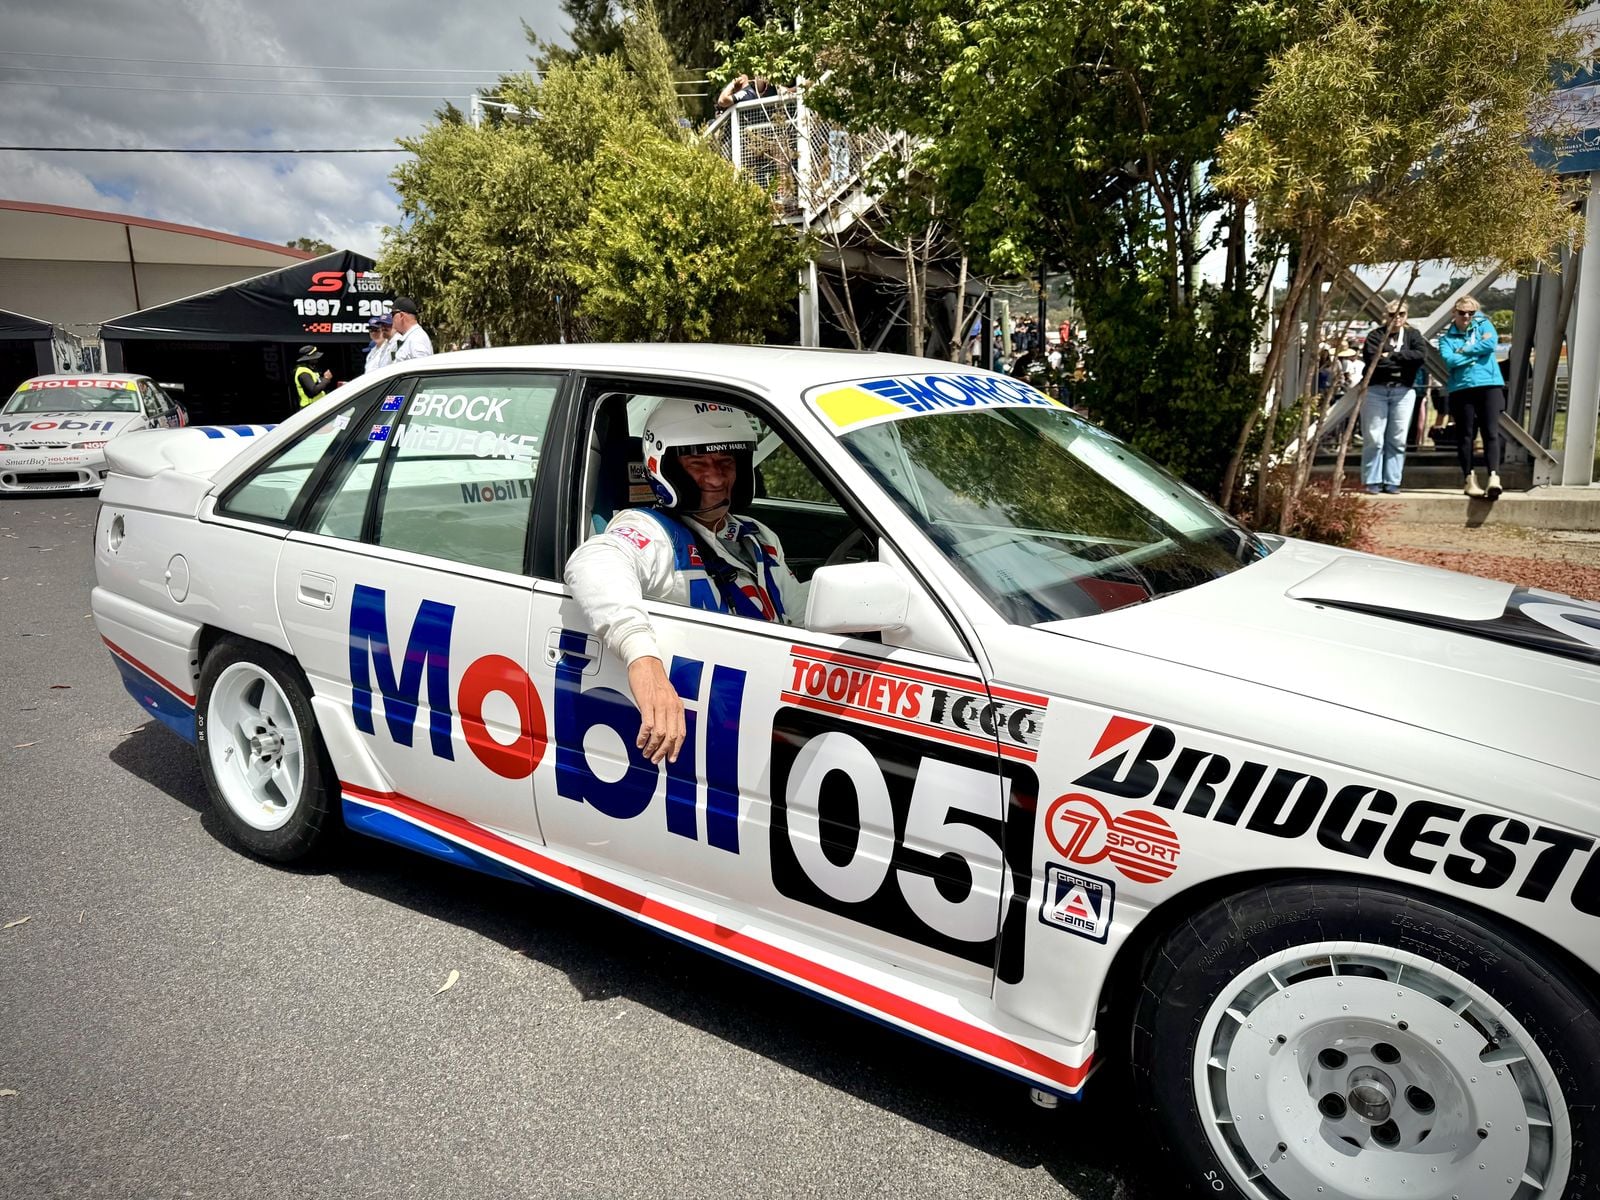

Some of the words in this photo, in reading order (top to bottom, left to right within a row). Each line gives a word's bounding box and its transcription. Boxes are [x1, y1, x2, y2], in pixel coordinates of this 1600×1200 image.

[293, 298, 341, 316] 1997
[28, 380, 128, 390] HOLDEN
[894, 375, 1053, 411] MONROE
[408, 393, 512, 423] BROCK
[0, 420, 114, 433] Mobil
[391, 424, 539, 461] MIEDECKE
[706, 444, 728, 452] KENNY
[460, 480, 517, 504] Mobil
[791, 658, 924, 719] TOOHEYS
[929, 689, 1039, 745] 1000
[348, 583, 747, 855] Mobil
[785, 731, 1015, 943] 05
[1106, 831, 1181, 862] SPORT
[1058, 872, 1102, 891] GROUP
